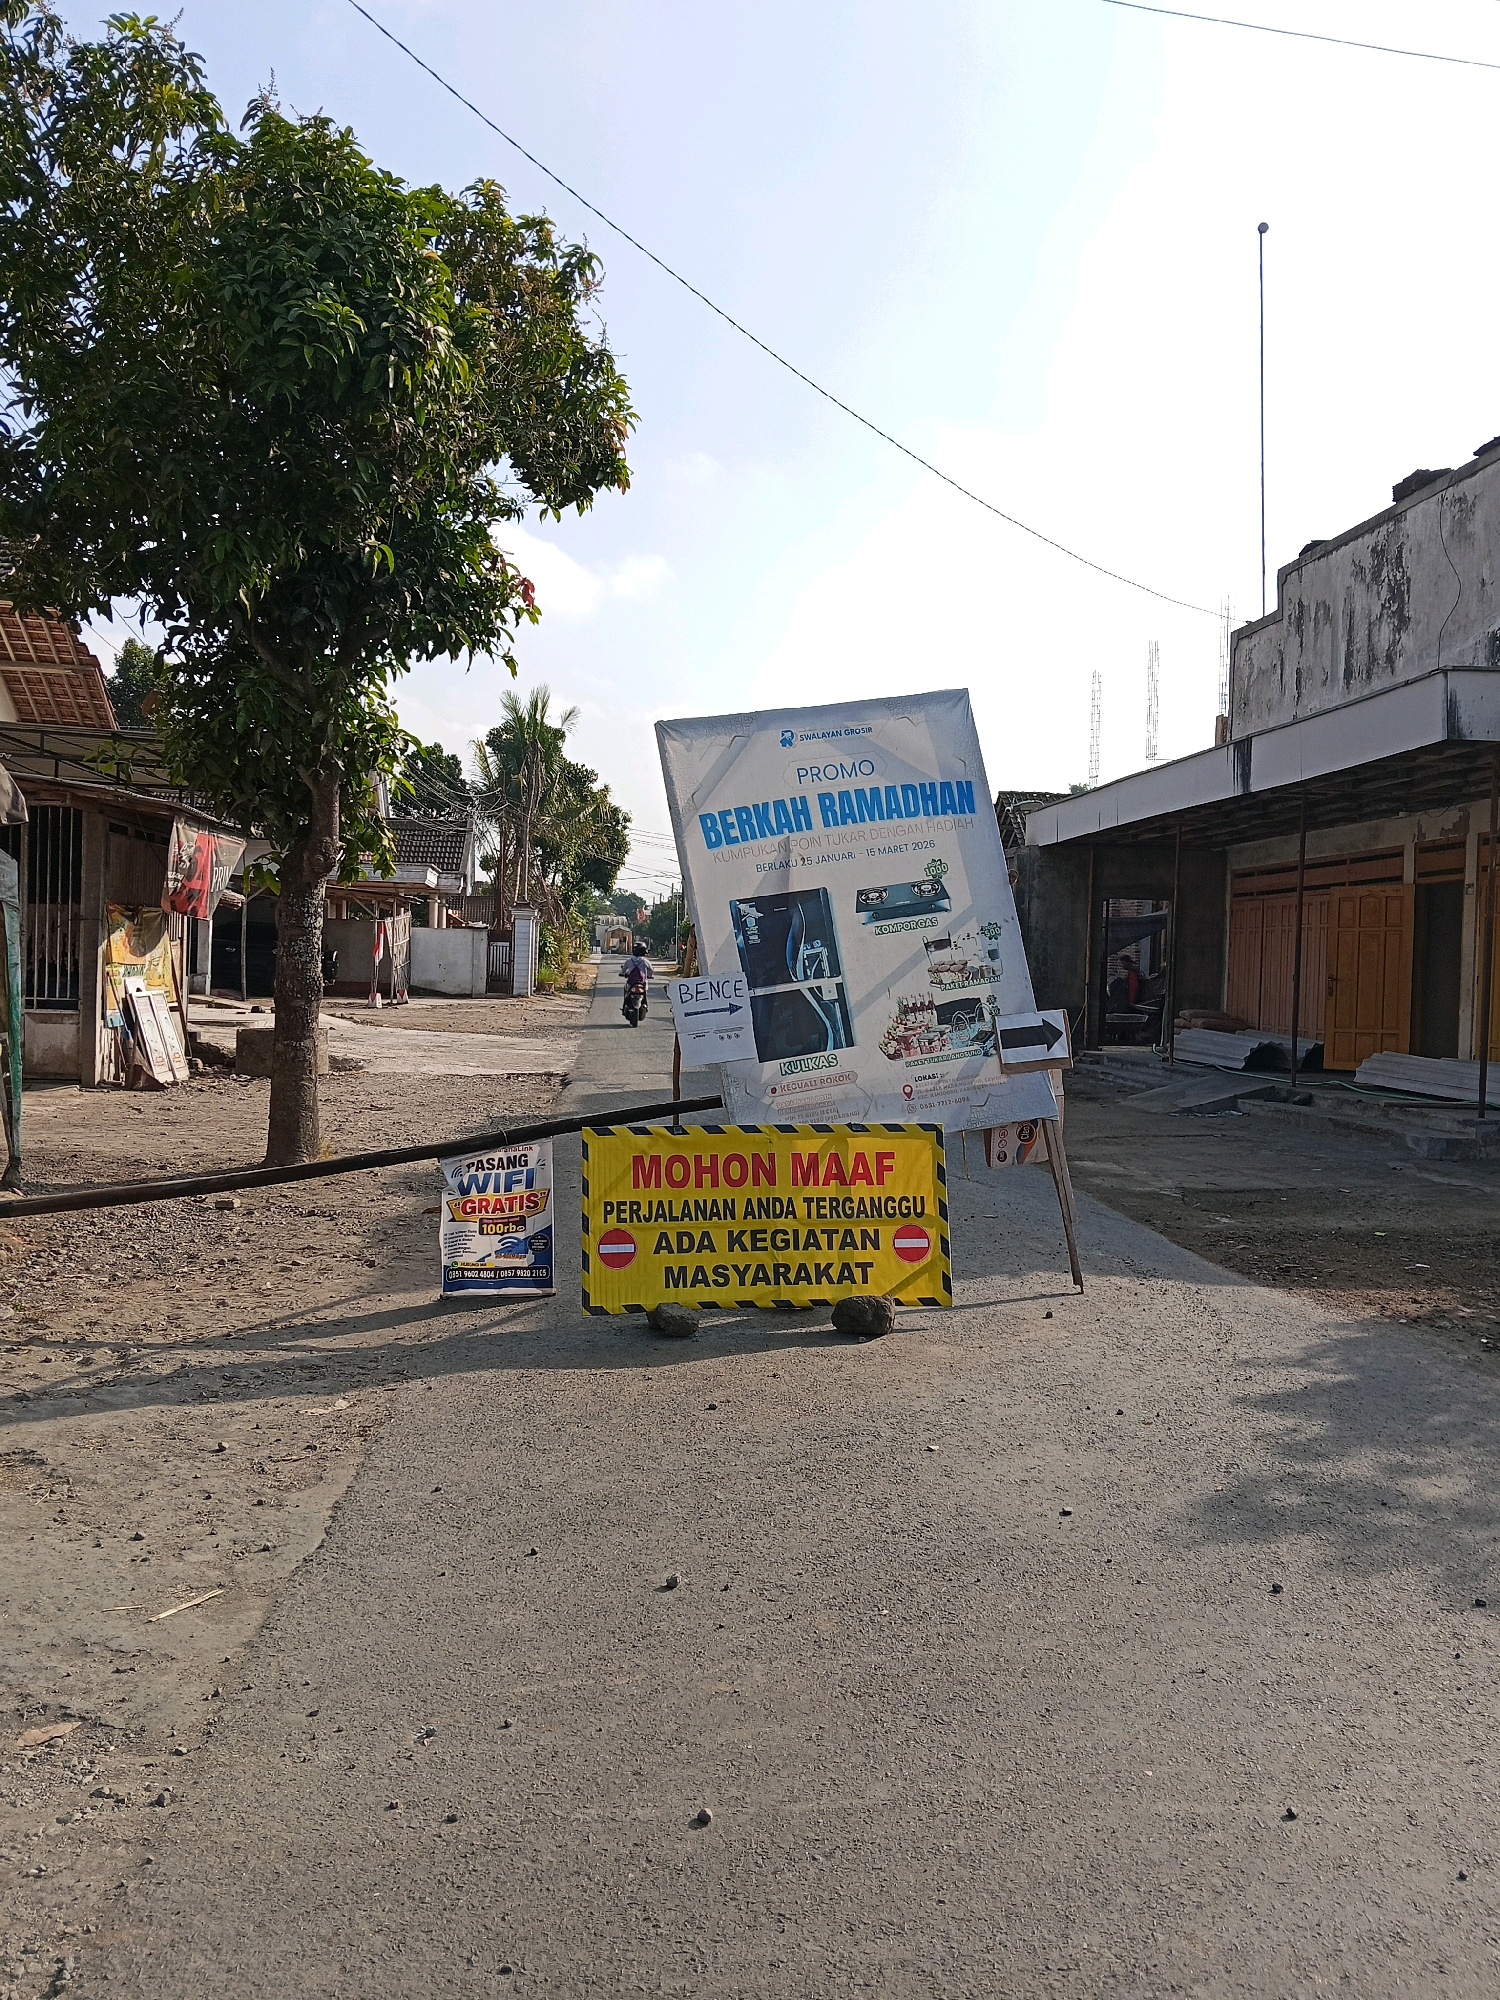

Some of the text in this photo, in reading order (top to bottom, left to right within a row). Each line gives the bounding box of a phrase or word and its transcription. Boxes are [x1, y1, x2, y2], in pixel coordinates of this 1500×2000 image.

[799, 726, 873, 742] SWALAYAN GROSIR
[796, 759, 875, 785] PROMO
[699, 780, 976, 850] BERKAH RAMADHAN
[712, 817, 974, 863] KUMPUKAN POIN TUKAR DENGAN HADIAH
[755, 858, 798, 873] BERLAKU
[801, 856, 813, 866] 25
[815, 850, 856, 865] JANUARI
[865, 847, 876, 857] 15
[878, 843, 909, 855] MARET
[911, 840, 936, 851] 2026
[924, 863, 949, 877] 1000
[875, 917, 938, 935] KOMPOR GAS
[984, 928, 1001, 937] 500
[678, 979, 744, 1005] BENCE
[940, 976, 1001, 991] PAKET RAMADAN
[779, 1054, 838, 1076] KULKAS
[905, 1059, 925, 1068] PAKET
[819, 1074, 852, 1085] ROKOK
[914, 1073, 939, 1082] LOKASI
[466, 1154, 528, 1173] PASANG
[632, 1151, 896, 1189] MOHON MAAF
[457, 1168, 535, 1196] WIFI
[603, 1195, 925, 1224] PERJALANAN ANDA TERGANGGU
[653, 1228, 880, 1255] ADA KEGIATAN
[463, 1269, 478, 1278] 9602
[479, 1270, 495, 1278] 4804
[500, 1269, 514, 1277] 0857
[516, 1268, 530, 1277] 9820
[664, 1261, 874, 1289] MASYARAKAT
